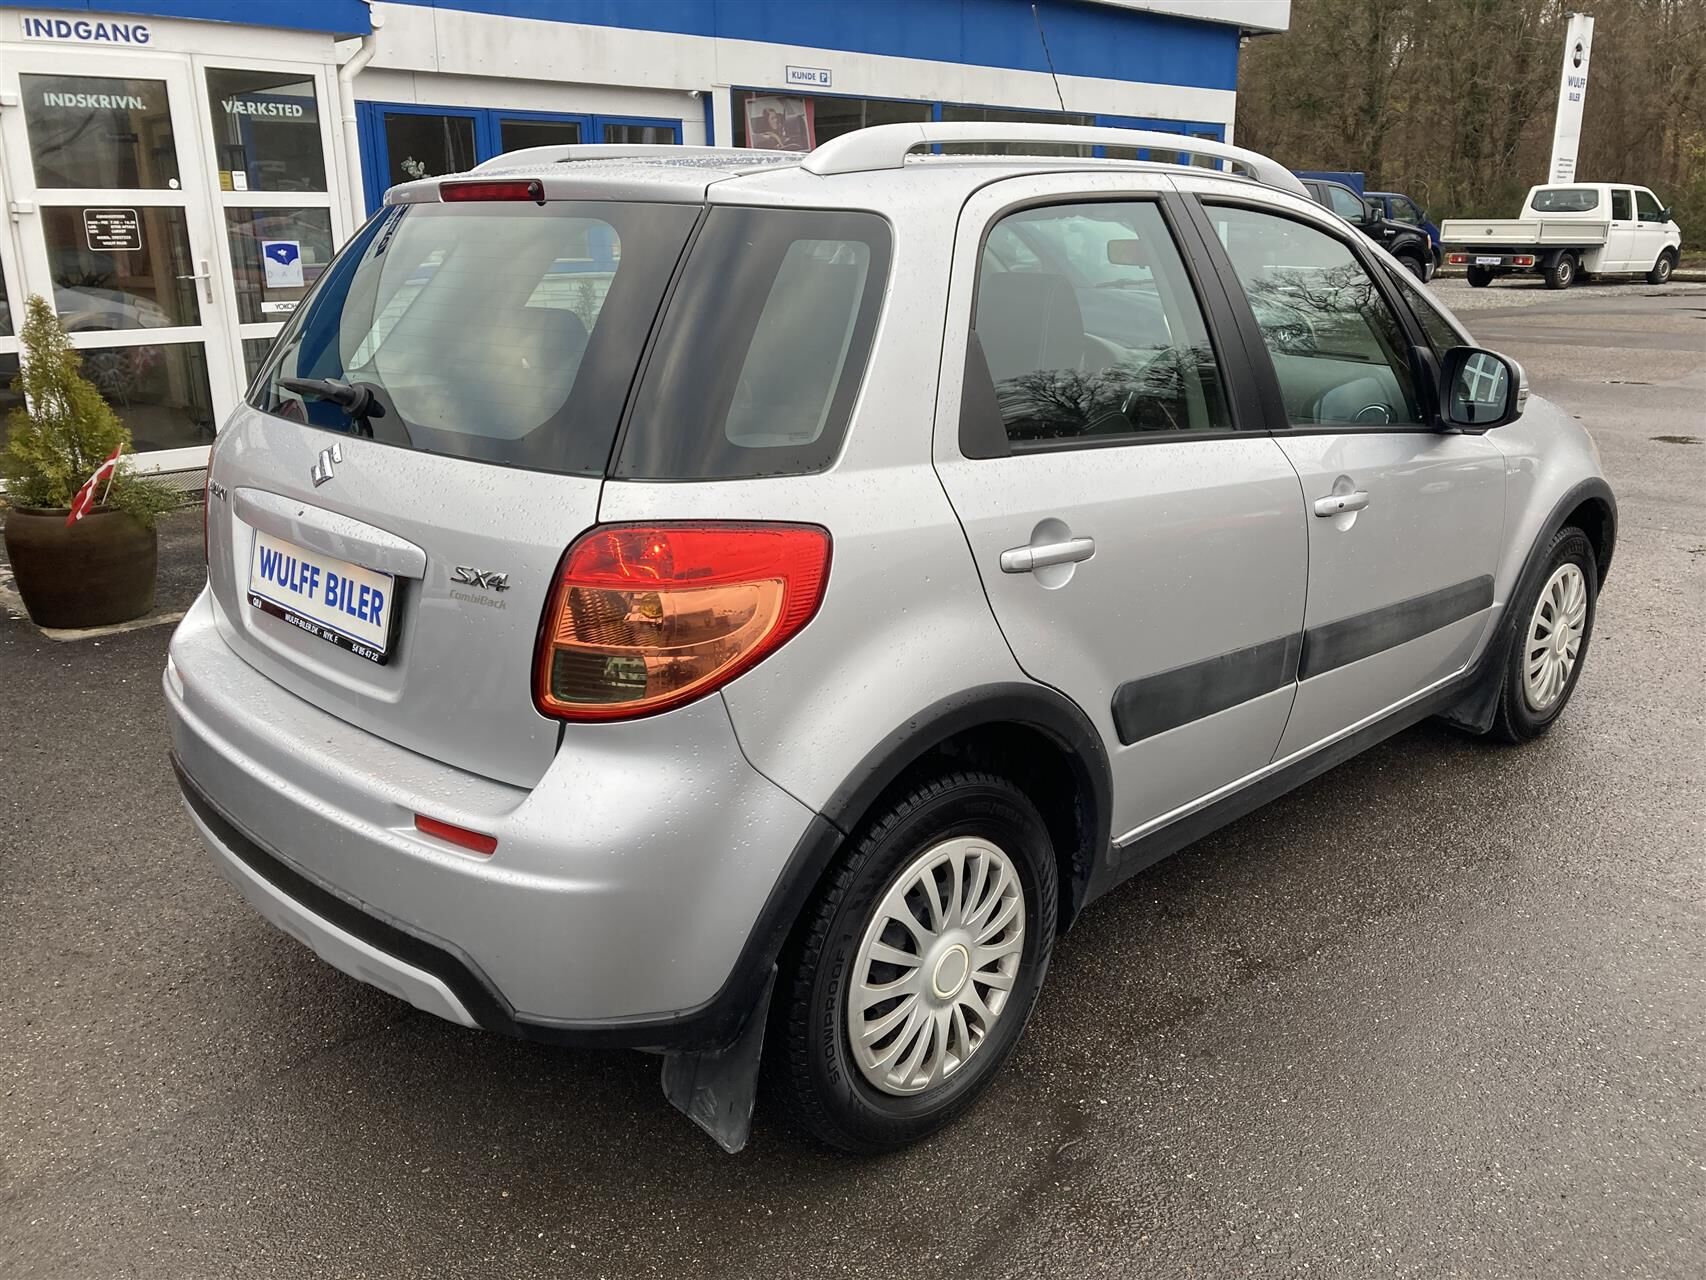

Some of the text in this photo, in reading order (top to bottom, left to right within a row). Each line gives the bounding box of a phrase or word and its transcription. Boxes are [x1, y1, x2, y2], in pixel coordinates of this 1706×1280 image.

[24, 18, 150, 43] INDGANG
[792, 71, 816, 80] KUNDE
[1568, 75, 1586, 89] WULFF
[44, 92, 146, 110] INDSKRIVN.
[222, 100, 303, 117] VÆRKSTED
[260, 546, 384, 627] WULFF BILER
[449, 565, 511, 592] SX4
[449, 589, 507, 610] CombiBack
[823, 949, 846, 1085] SNOWPROOF
